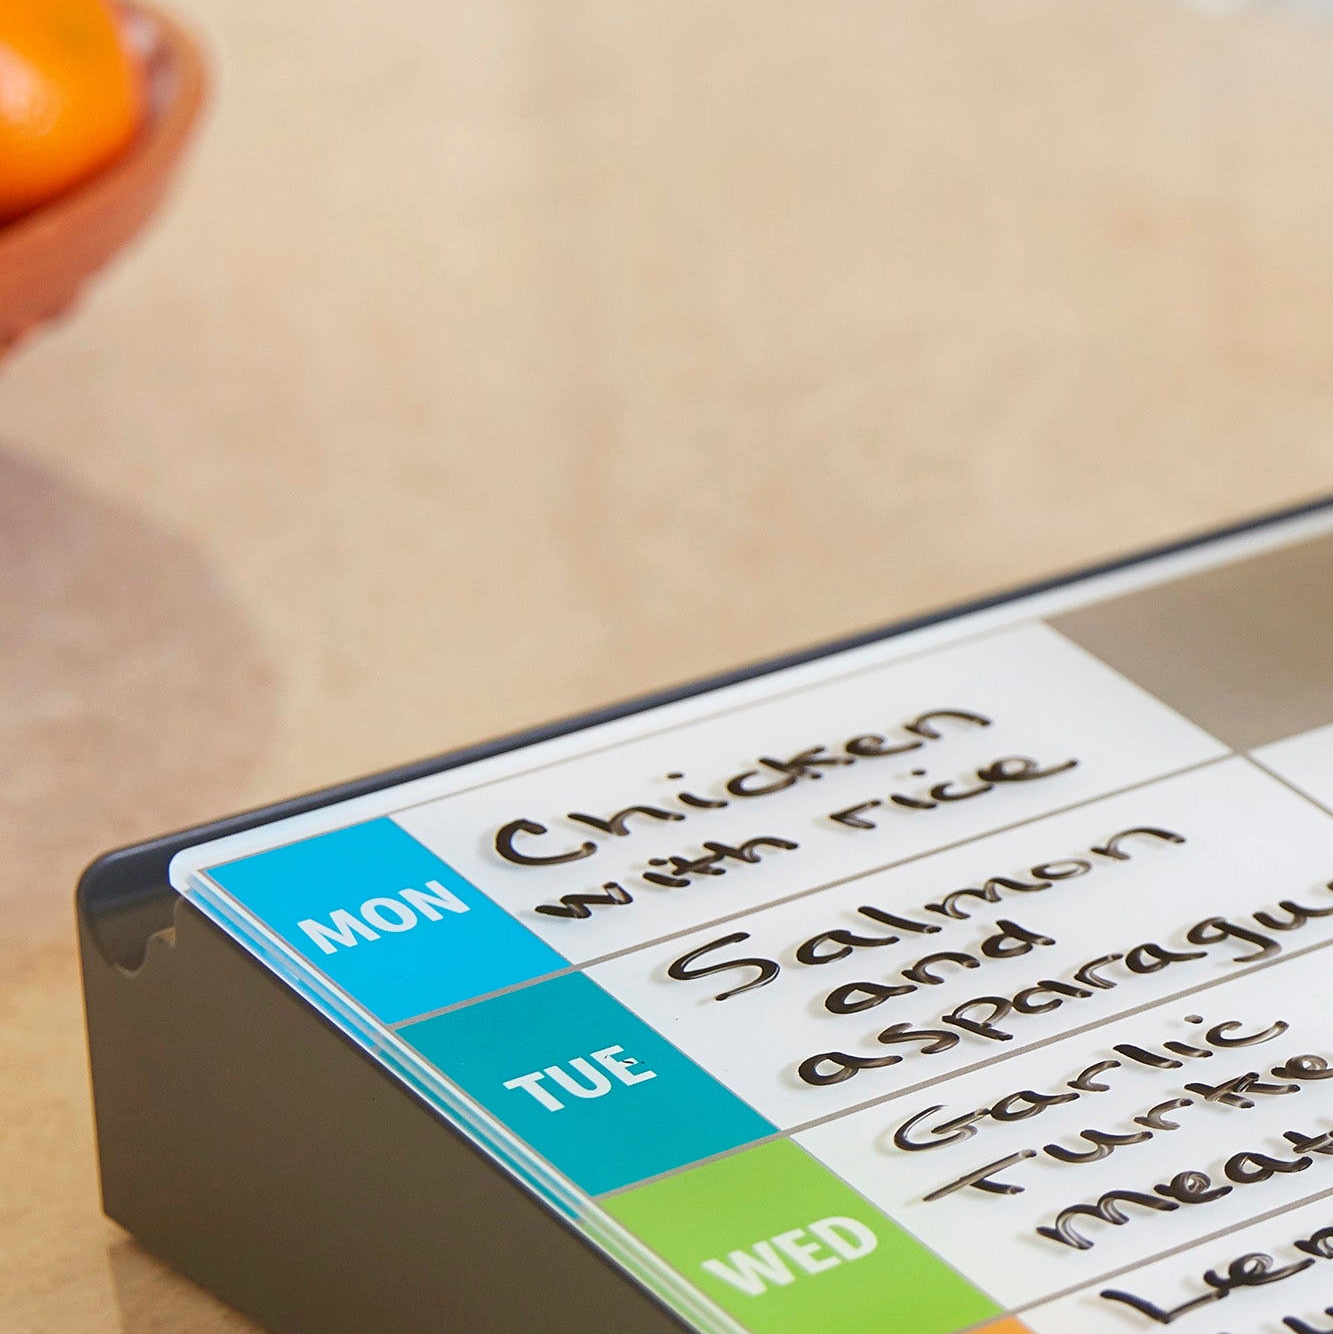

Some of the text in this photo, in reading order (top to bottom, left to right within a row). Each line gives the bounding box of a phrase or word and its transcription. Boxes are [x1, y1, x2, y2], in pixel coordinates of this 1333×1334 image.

[494, 706, 992, 866] Chicken
[535, 752, 1079, 921] with rice
[297, 880, 470, 955] MON
[667, 825, 1186, 1001] Salmon
[824, 919, 1057, 1014] and
[502, 1045, 657, 1112] TUE
[893, 1014, 1289, 1152] Garlic
[701, 1215, 879, 1298] WED
